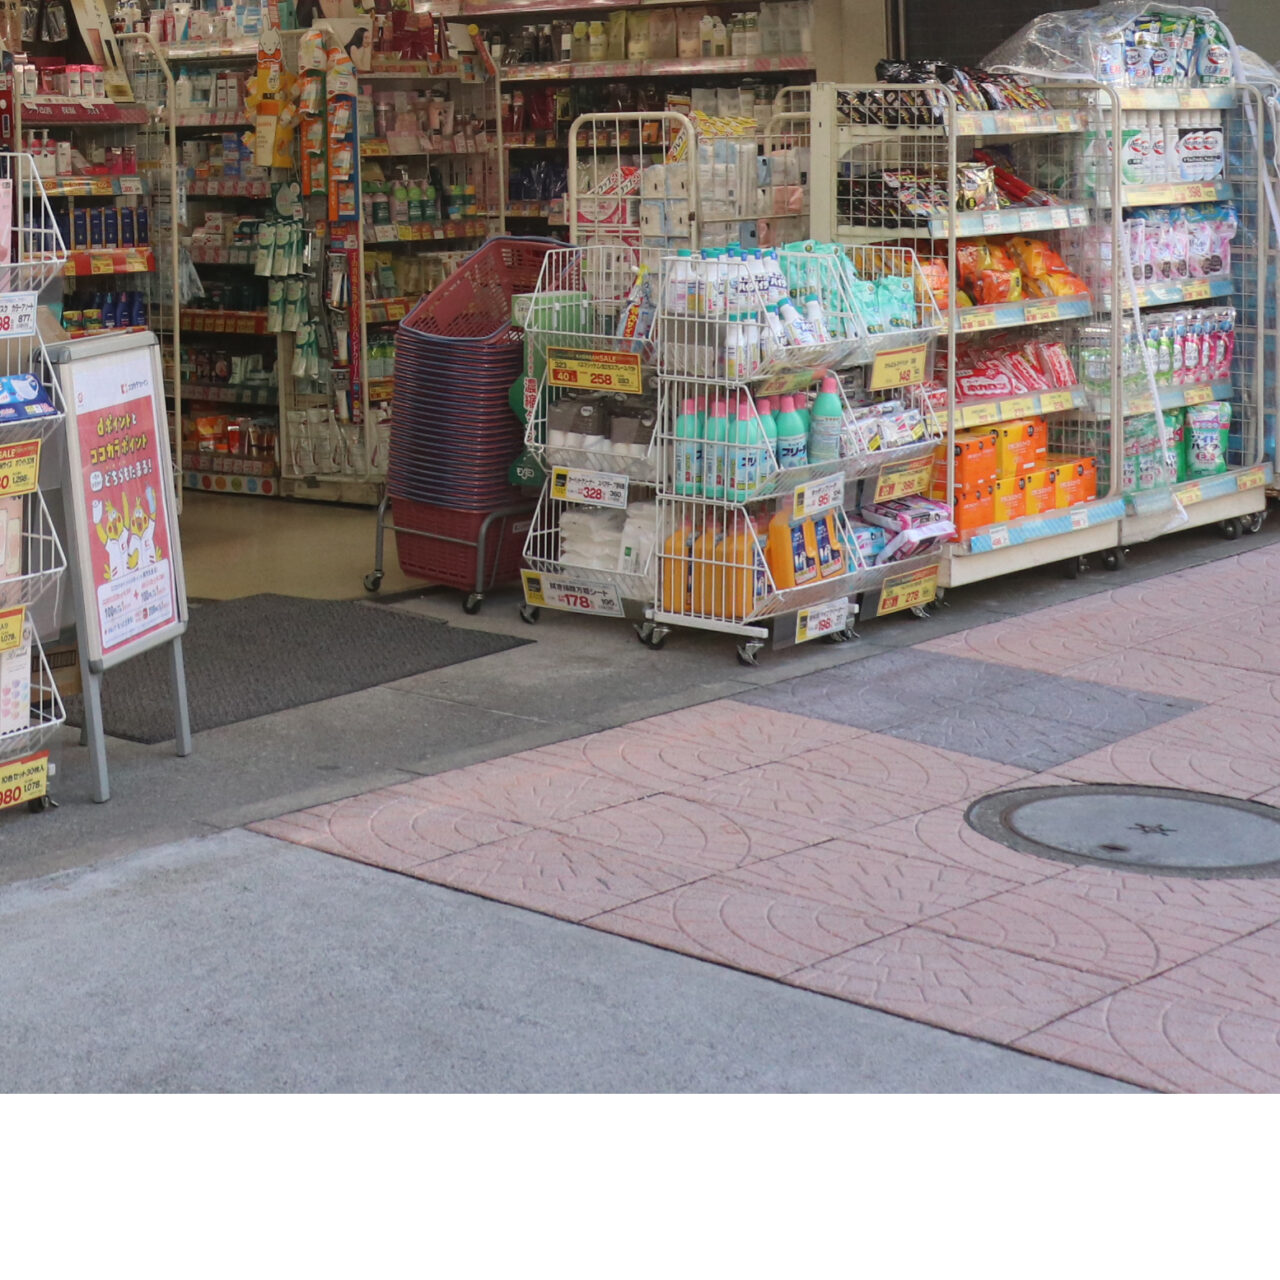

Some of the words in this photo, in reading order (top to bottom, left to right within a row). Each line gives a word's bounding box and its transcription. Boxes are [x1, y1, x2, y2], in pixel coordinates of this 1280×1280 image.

[590, 373, 612, 385] 258
[583, 487, 603, 500] 328
[564, 593, 591, 609] 178
